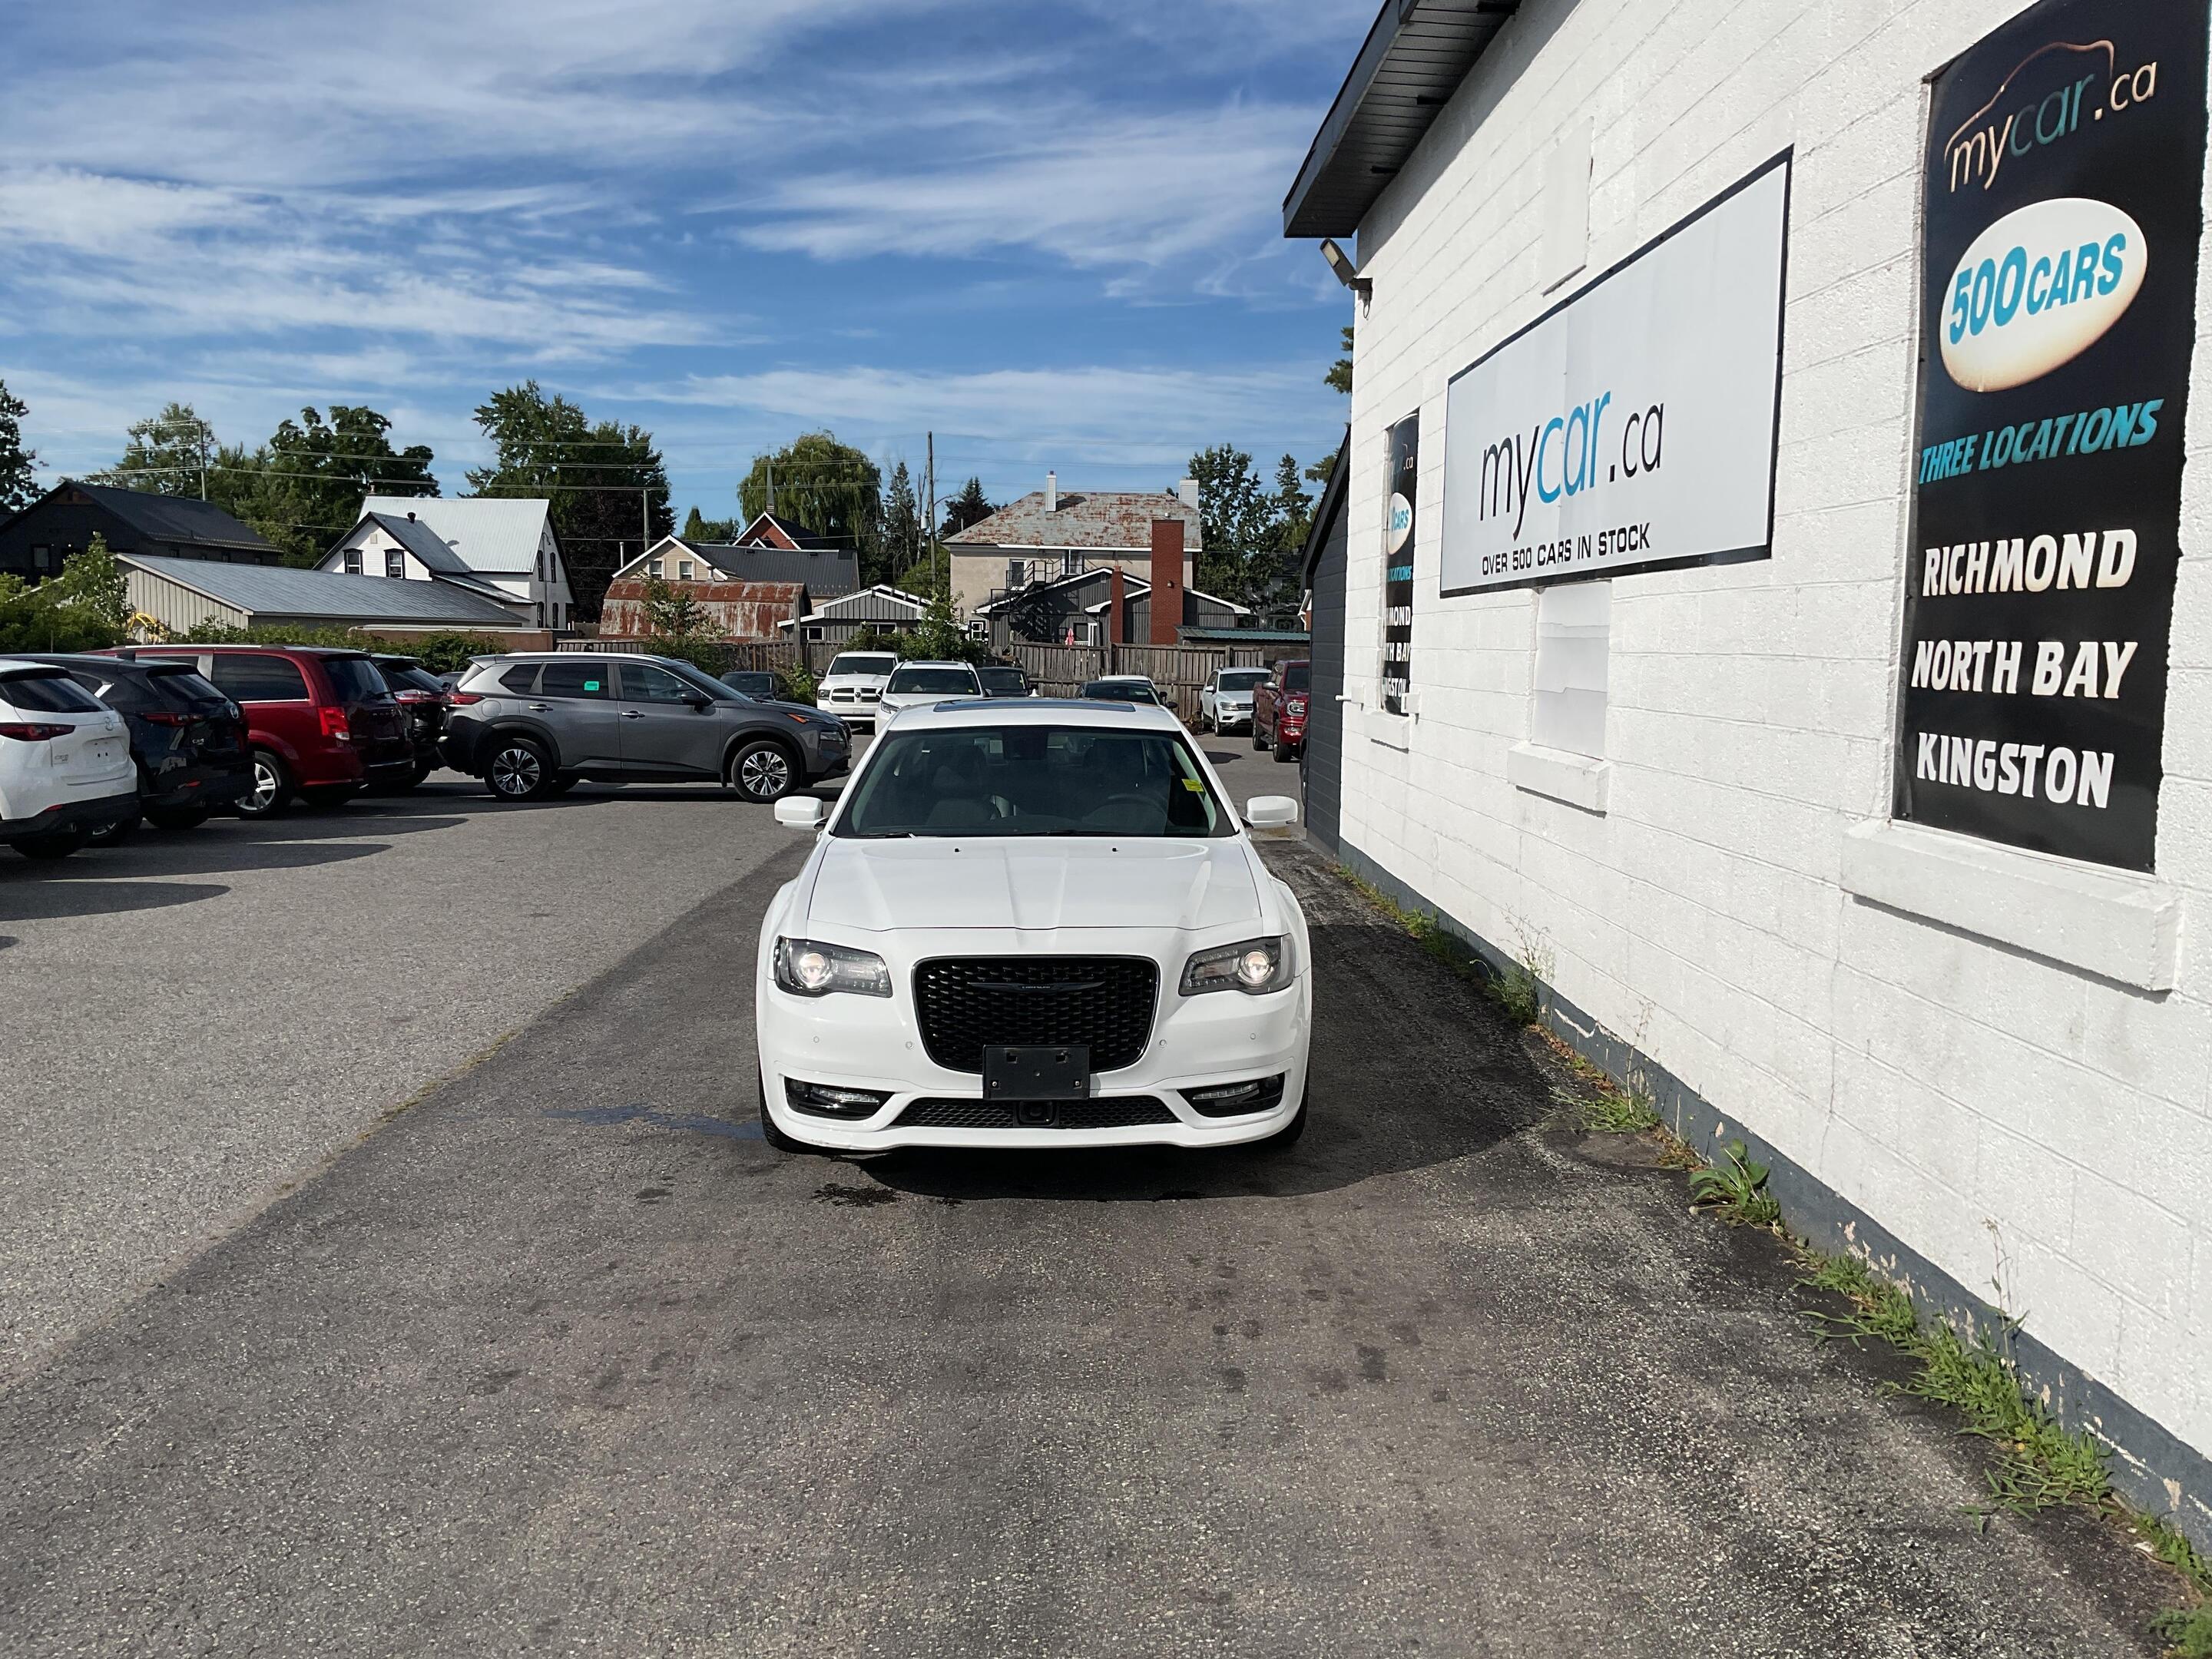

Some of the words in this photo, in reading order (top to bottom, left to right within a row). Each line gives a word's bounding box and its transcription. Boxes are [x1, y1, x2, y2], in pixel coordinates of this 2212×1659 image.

[1950, 61, 2157, 193] mycar.ca
[1480, 390, 1664, 541] mycar.ca
[1919, 433, 1979, 485] THREE
[1979, 399, 2164, 470] LOCATIONS
[1482, 552, 1508, 575] OVER
[1512, 547, 1532, 571] 500
[1537, 538, 1571, 567] CARS
[1578, 535, 1591, 559] IN
[1598, 523, 1651, 556] STOCK
[1922, 529, 2137, 597] RICHMOND
[1911, 639, 2022, 694] NORTH
[2032, 641, 2138, 699] BAY
[1916, 732, 2114, 809] KINGSTON
